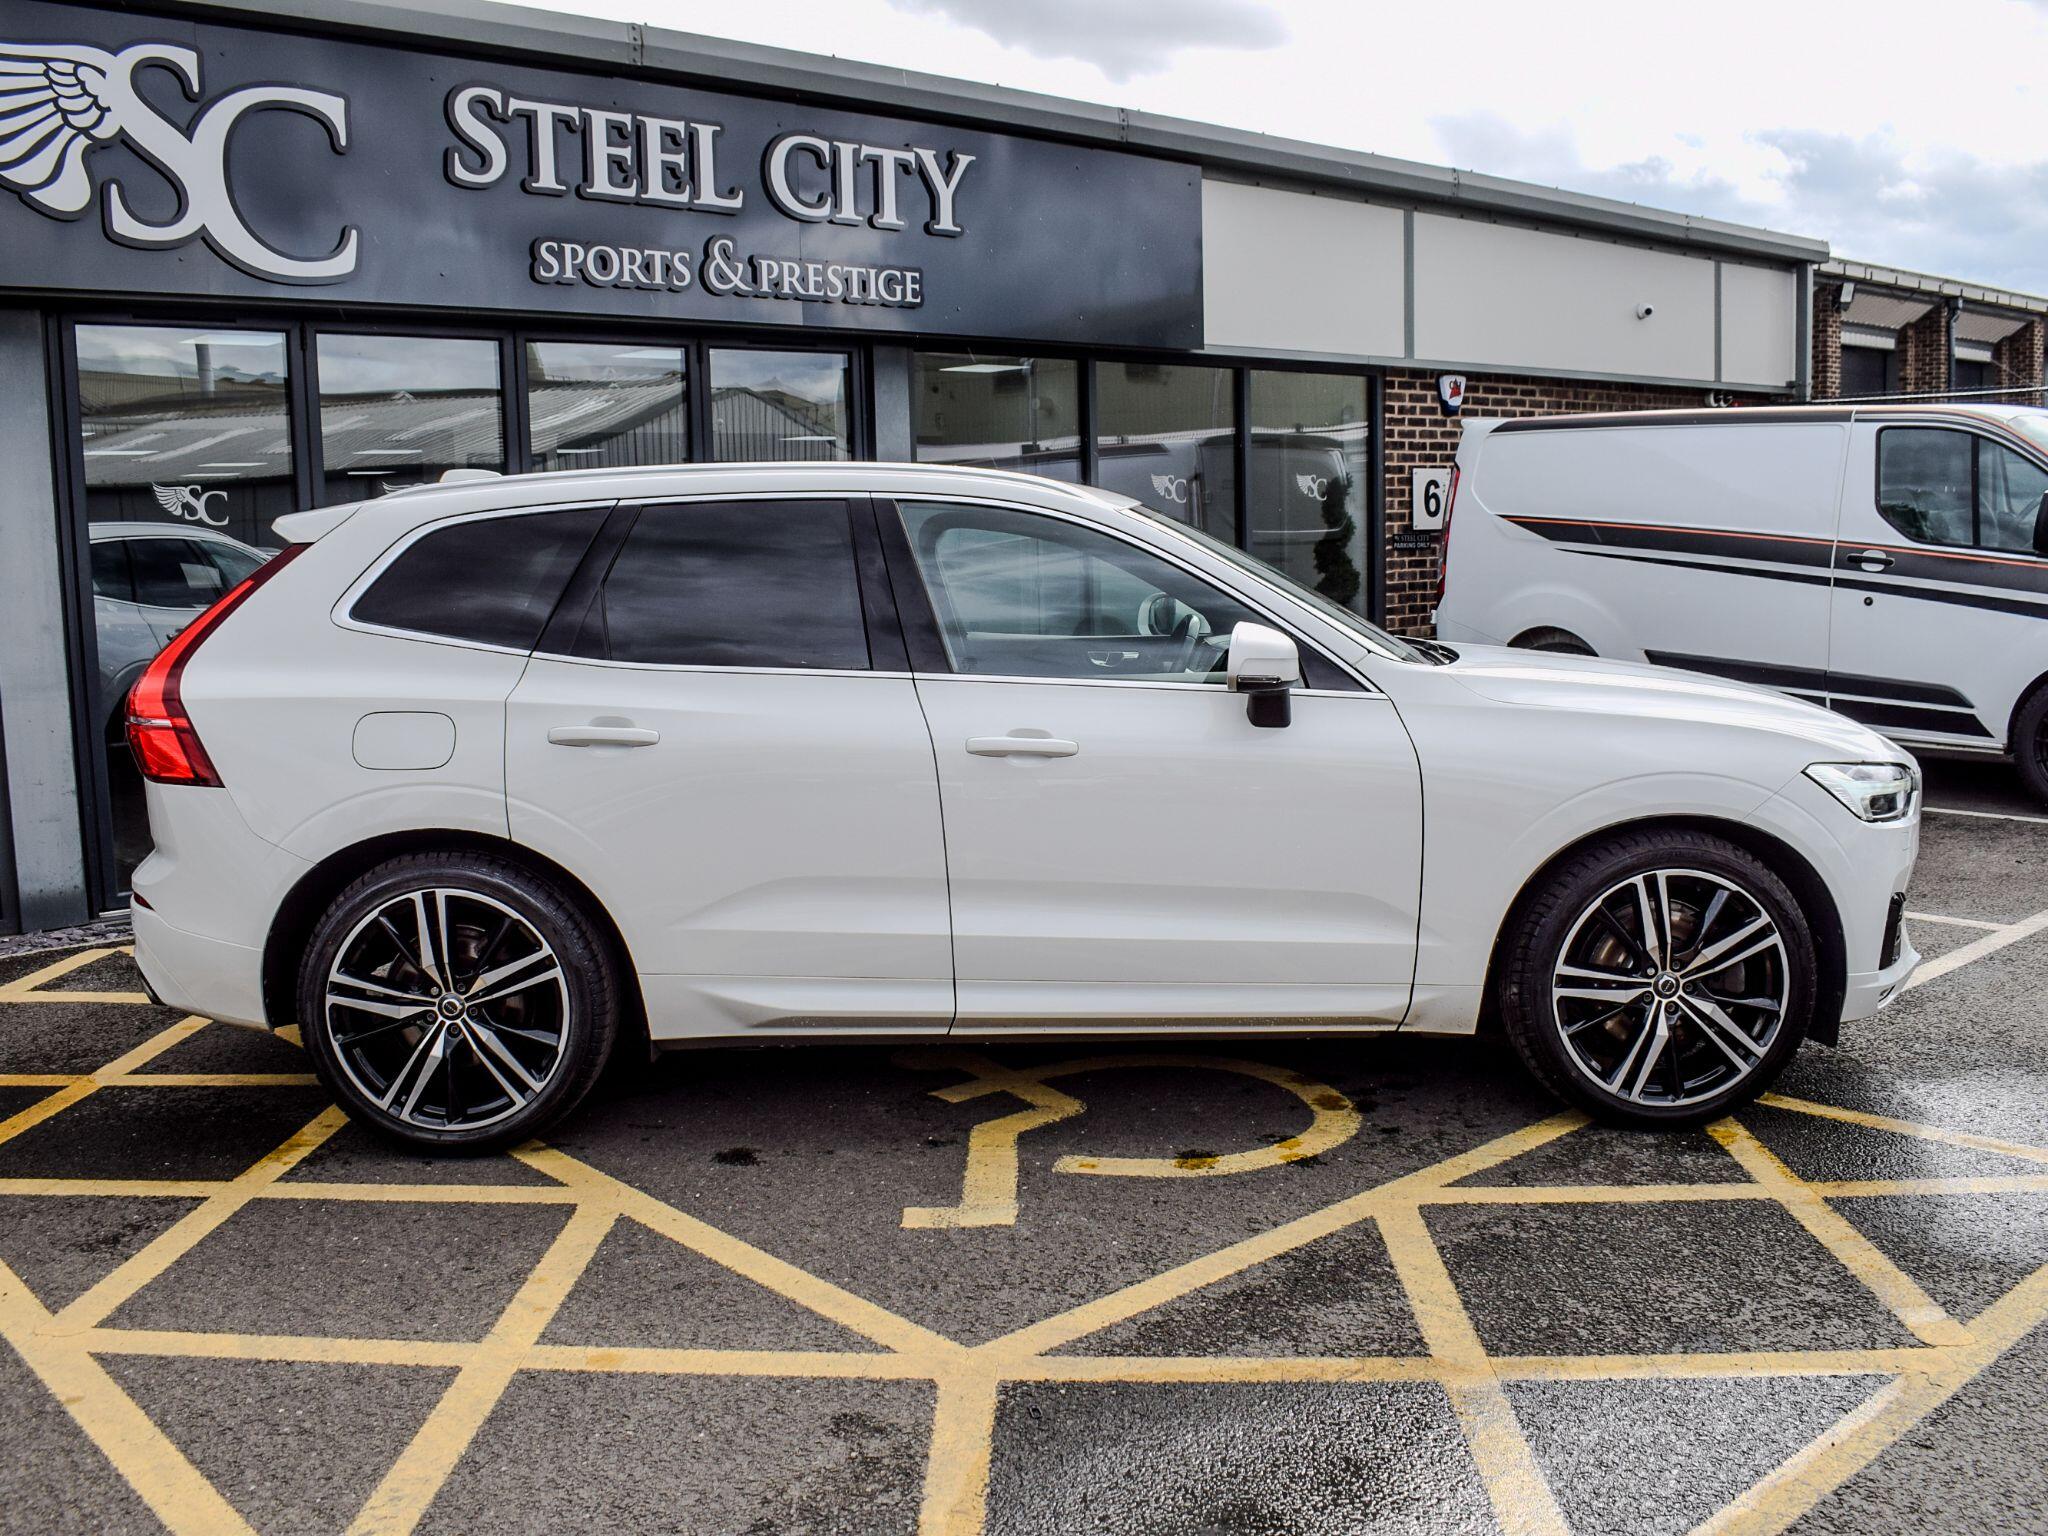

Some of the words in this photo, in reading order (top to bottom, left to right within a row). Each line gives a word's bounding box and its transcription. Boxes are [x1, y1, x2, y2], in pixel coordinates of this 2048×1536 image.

[108, 42, 359, 279] SC
[453, 85, 744, 209] STEEL
[768, 134, 976, 232] CITY
[537, 240, 691, 287] SPORTS
[706, 238, 754, 292] &
[757, 258, 922, 304] PRESTIGE
[184, 484, 230, 526] SC
[1165, 474, 1187, 503] SC
[1308, 473, 1328, 501] SC
[1423, 479, 1441, 517] 6
